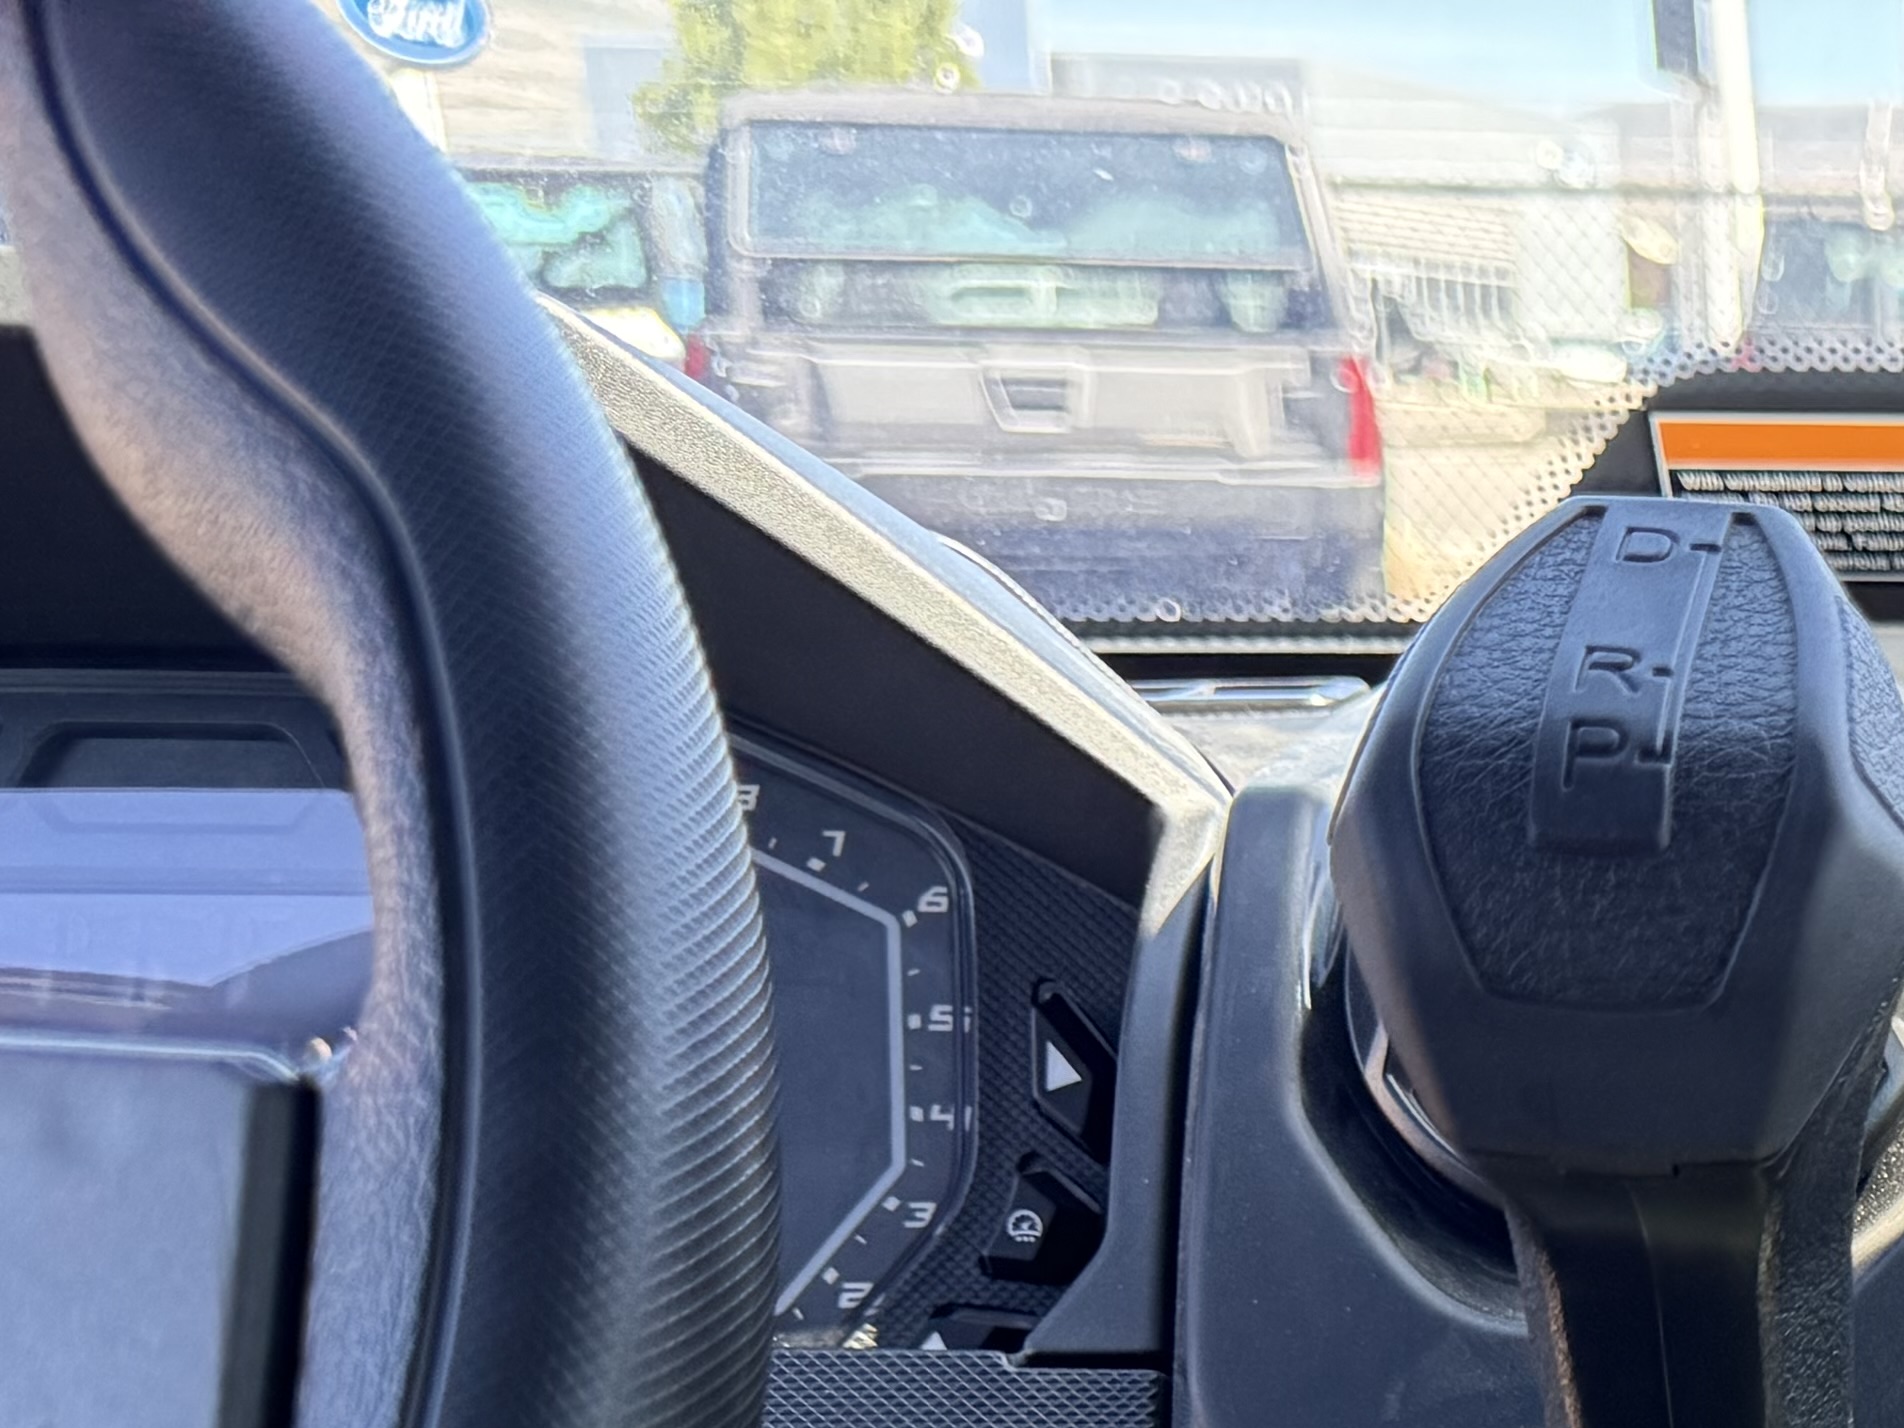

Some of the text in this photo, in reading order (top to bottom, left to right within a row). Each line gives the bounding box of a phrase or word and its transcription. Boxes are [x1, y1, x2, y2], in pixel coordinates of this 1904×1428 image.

[1725, 472, 1823, 493] windshield
[1615, 525, 1679, 563] D
[1574, 645, 1641, 693] R
[1561, 718, 1630, 790] P
[822, 830, 846, 857] 7
[917, 886, 949, 914] 6
[927, 1006, 954, 1032] 5
[929, 1105, 956, 1130] 4
[902, 1202, 938, 1229] 3
[837, 1281, 874, 1309] 2
